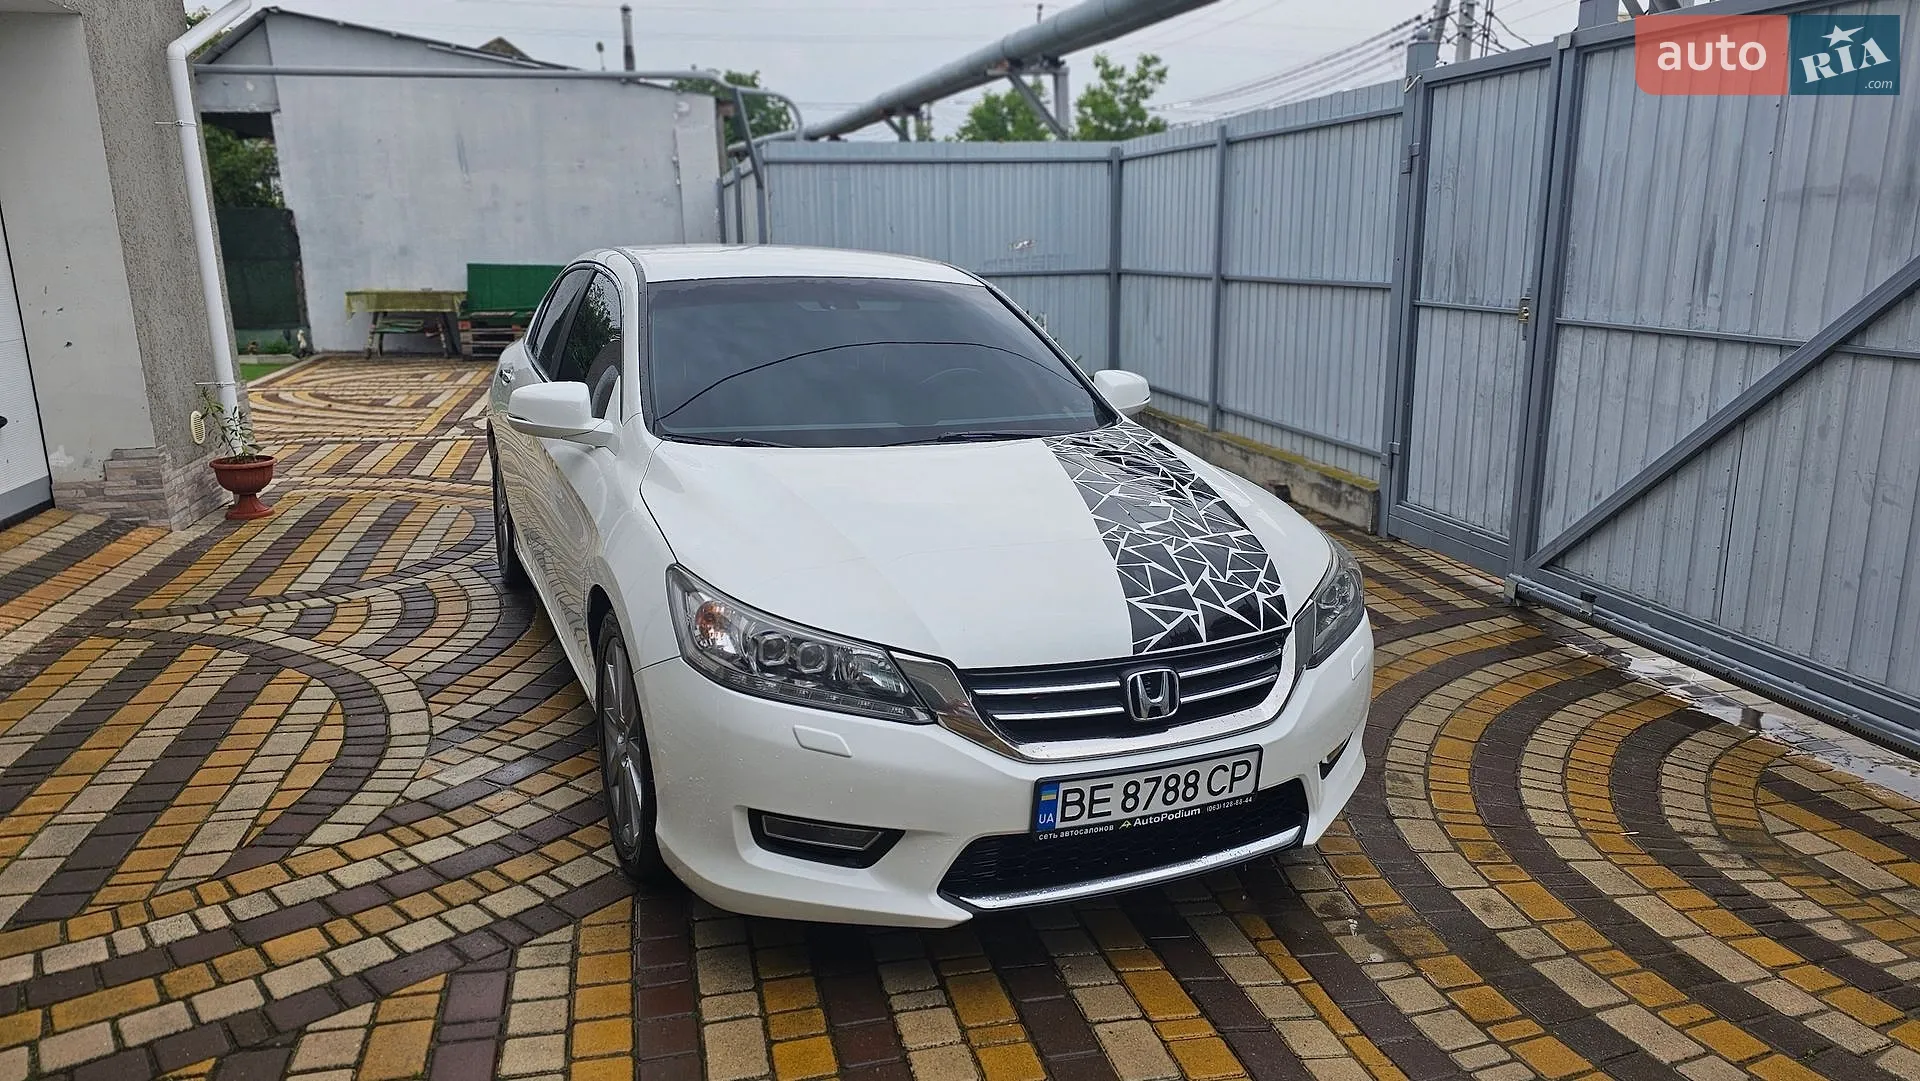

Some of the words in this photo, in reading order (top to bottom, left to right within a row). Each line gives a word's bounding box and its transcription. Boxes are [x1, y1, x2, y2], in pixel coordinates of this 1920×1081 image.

[1060, 783, 1114, 822] BE
[1120, 769, 1200, 813] 8788
[1206, 759, 1251, 797] CP
[1038, 813, 1054, 824] UA
[1133, 807, 1201, 827] AutoPodium
[1038, 832, 1058, 840] сеть
[1059, 824, 1114, 838] автосалонов
